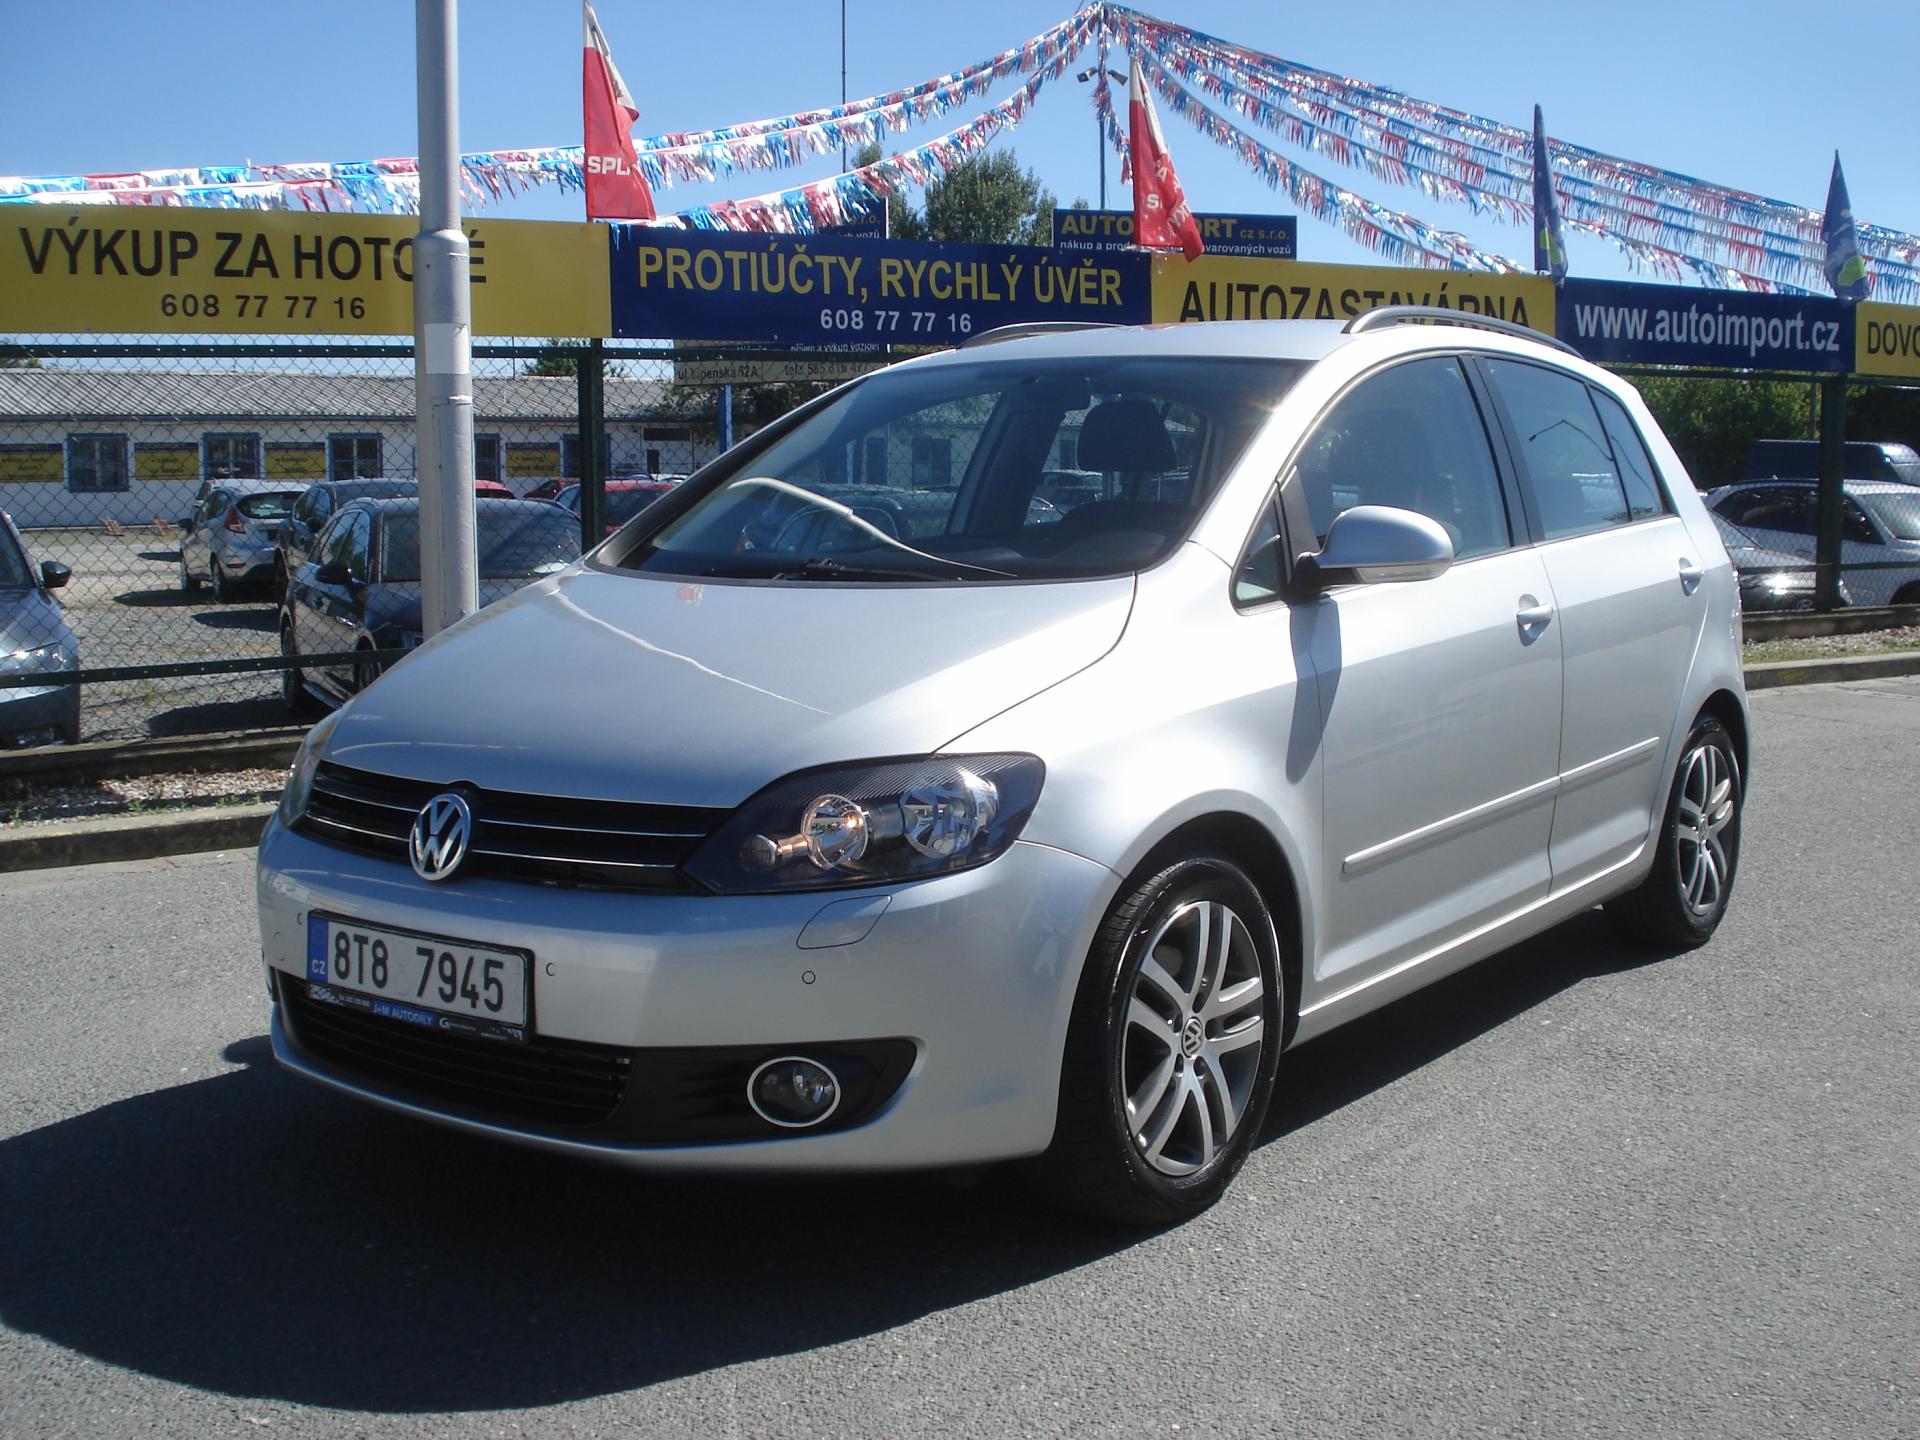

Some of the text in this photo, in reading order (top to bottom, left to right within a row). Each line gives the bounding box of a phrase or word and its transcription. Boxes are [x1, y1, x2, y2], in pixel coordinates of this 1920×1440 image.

[587, 155, 631, 176] SPL
[1061, 215, 1237, 238] AUTORT
[1258, 229, 1291, 240] s.r.o.
[19, 215, 487, 284] VÝKUP ZA HOTOÉ
[1202, 243, 1266, 256] varovaných
[1267, 245, 1292, 255] vozů
[639, 242, 1123, 306] PROTIÚČTY, RYCHLÝ ÚVĚR
[161, 293, 366, 319] 608 77 77 16
[820, 308, 972, 334] 608 77 77 16
[1574, 302, 1841, 358] www.autoimport.cz
[311, 931, 504, 1013] CZ 8T8 7945
